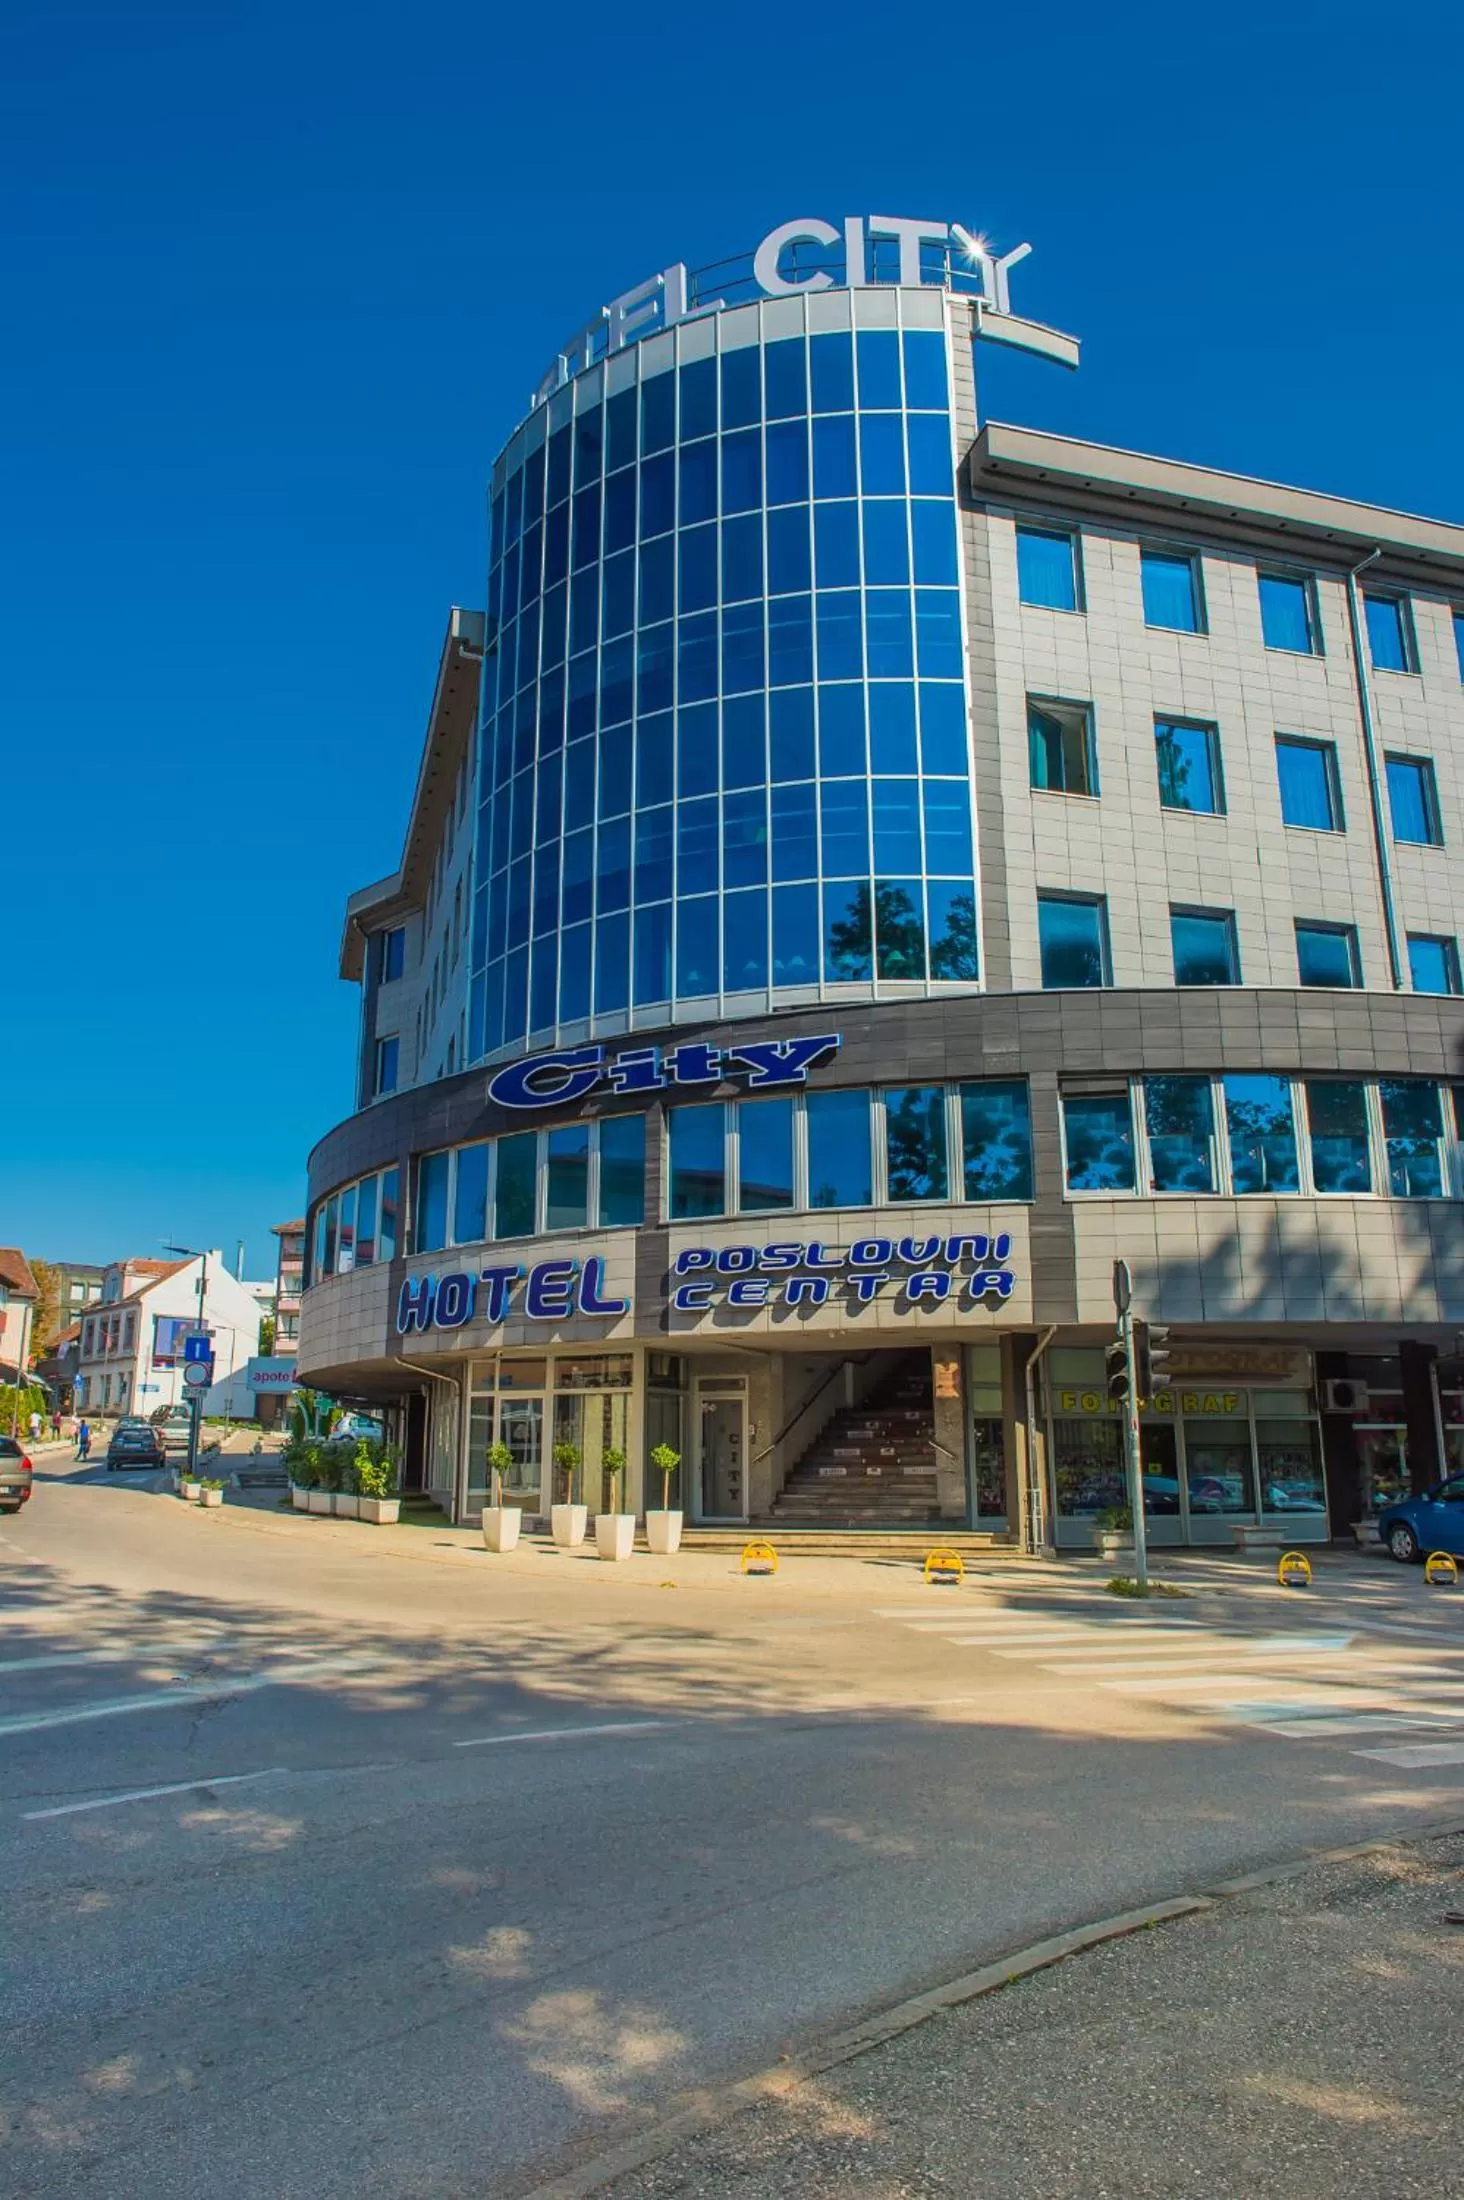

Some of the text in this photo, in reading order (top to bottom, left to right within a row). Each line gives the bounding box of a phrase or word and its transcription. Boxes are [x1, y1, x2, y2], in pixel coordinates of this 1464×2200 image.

[754, 215, 1032, 314] CITY
[488, 1034, 841, 1108] City
[675, 1270, 1015, 1310] CENTAR
[676, 1233, 1013, 1274] POSLOVNI
[398, 1255, 631, 1334] HOTEL
